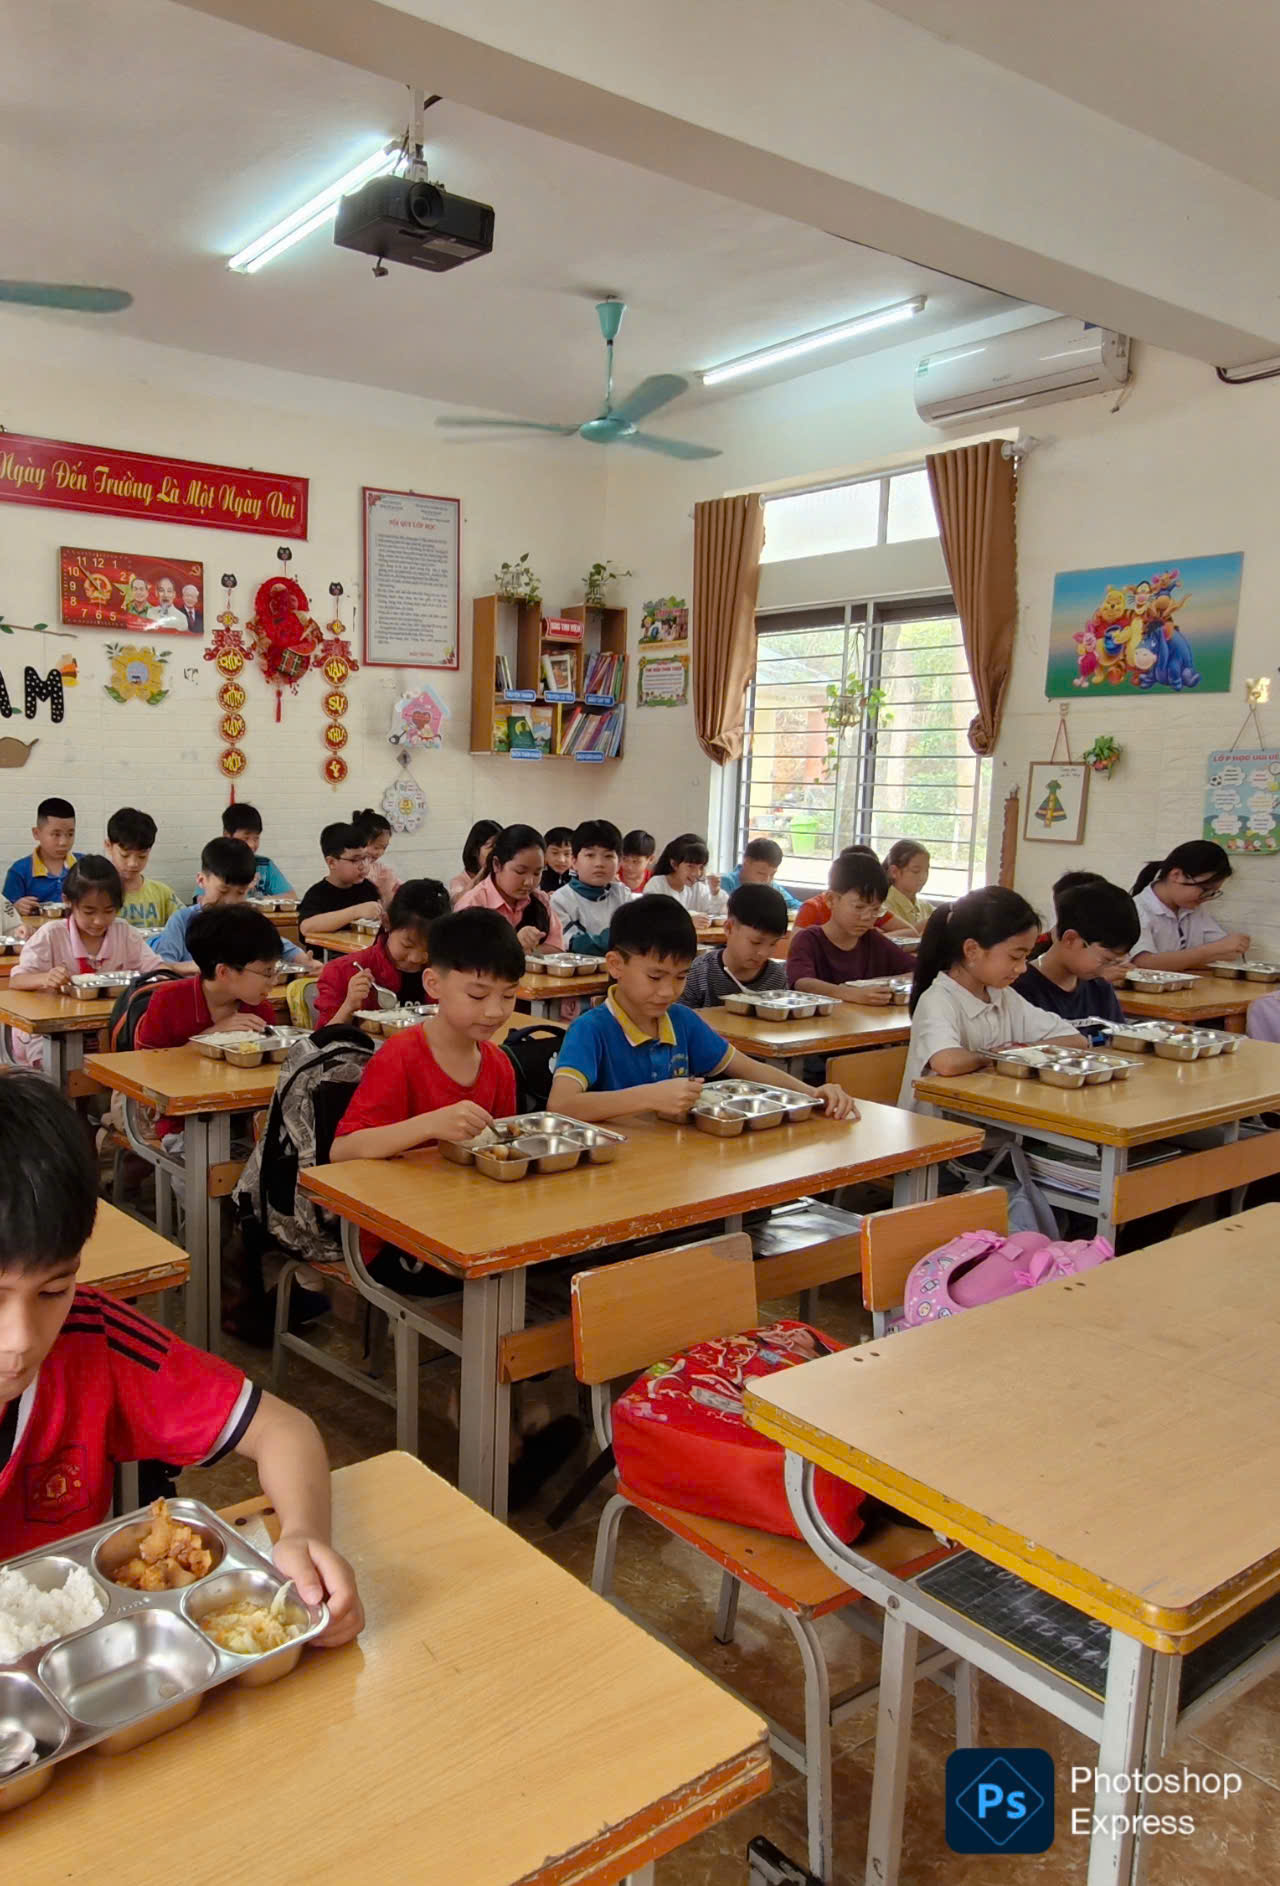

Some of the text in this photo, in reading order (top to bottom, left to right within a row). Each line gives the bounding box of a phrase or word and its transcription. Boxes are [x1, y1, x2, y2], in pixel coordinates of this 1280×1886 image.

[51, 459, 87, 491] Đến
[94, 465, 153, 506] Trường
[156, 475, 179, 504] Là
[182, 480, 215, 514] Một
[219, 484, 263, 520] Ngày
[266, 491, 295, 519] Vui
[77, 556, 87, 566] 11
[93, 558, 104, 568] 12
[113, 560, 117, 569] 1
[68, 567, 80, 576] 10
[120, 572, 126, 581] 2
[70, 581, 76, 591] 9
[70, 597, 77, 606] 8
[81, 608, 88, 617] 7
[96, 610, 102, 620] 6
[110, 612, 117, 621] 5
